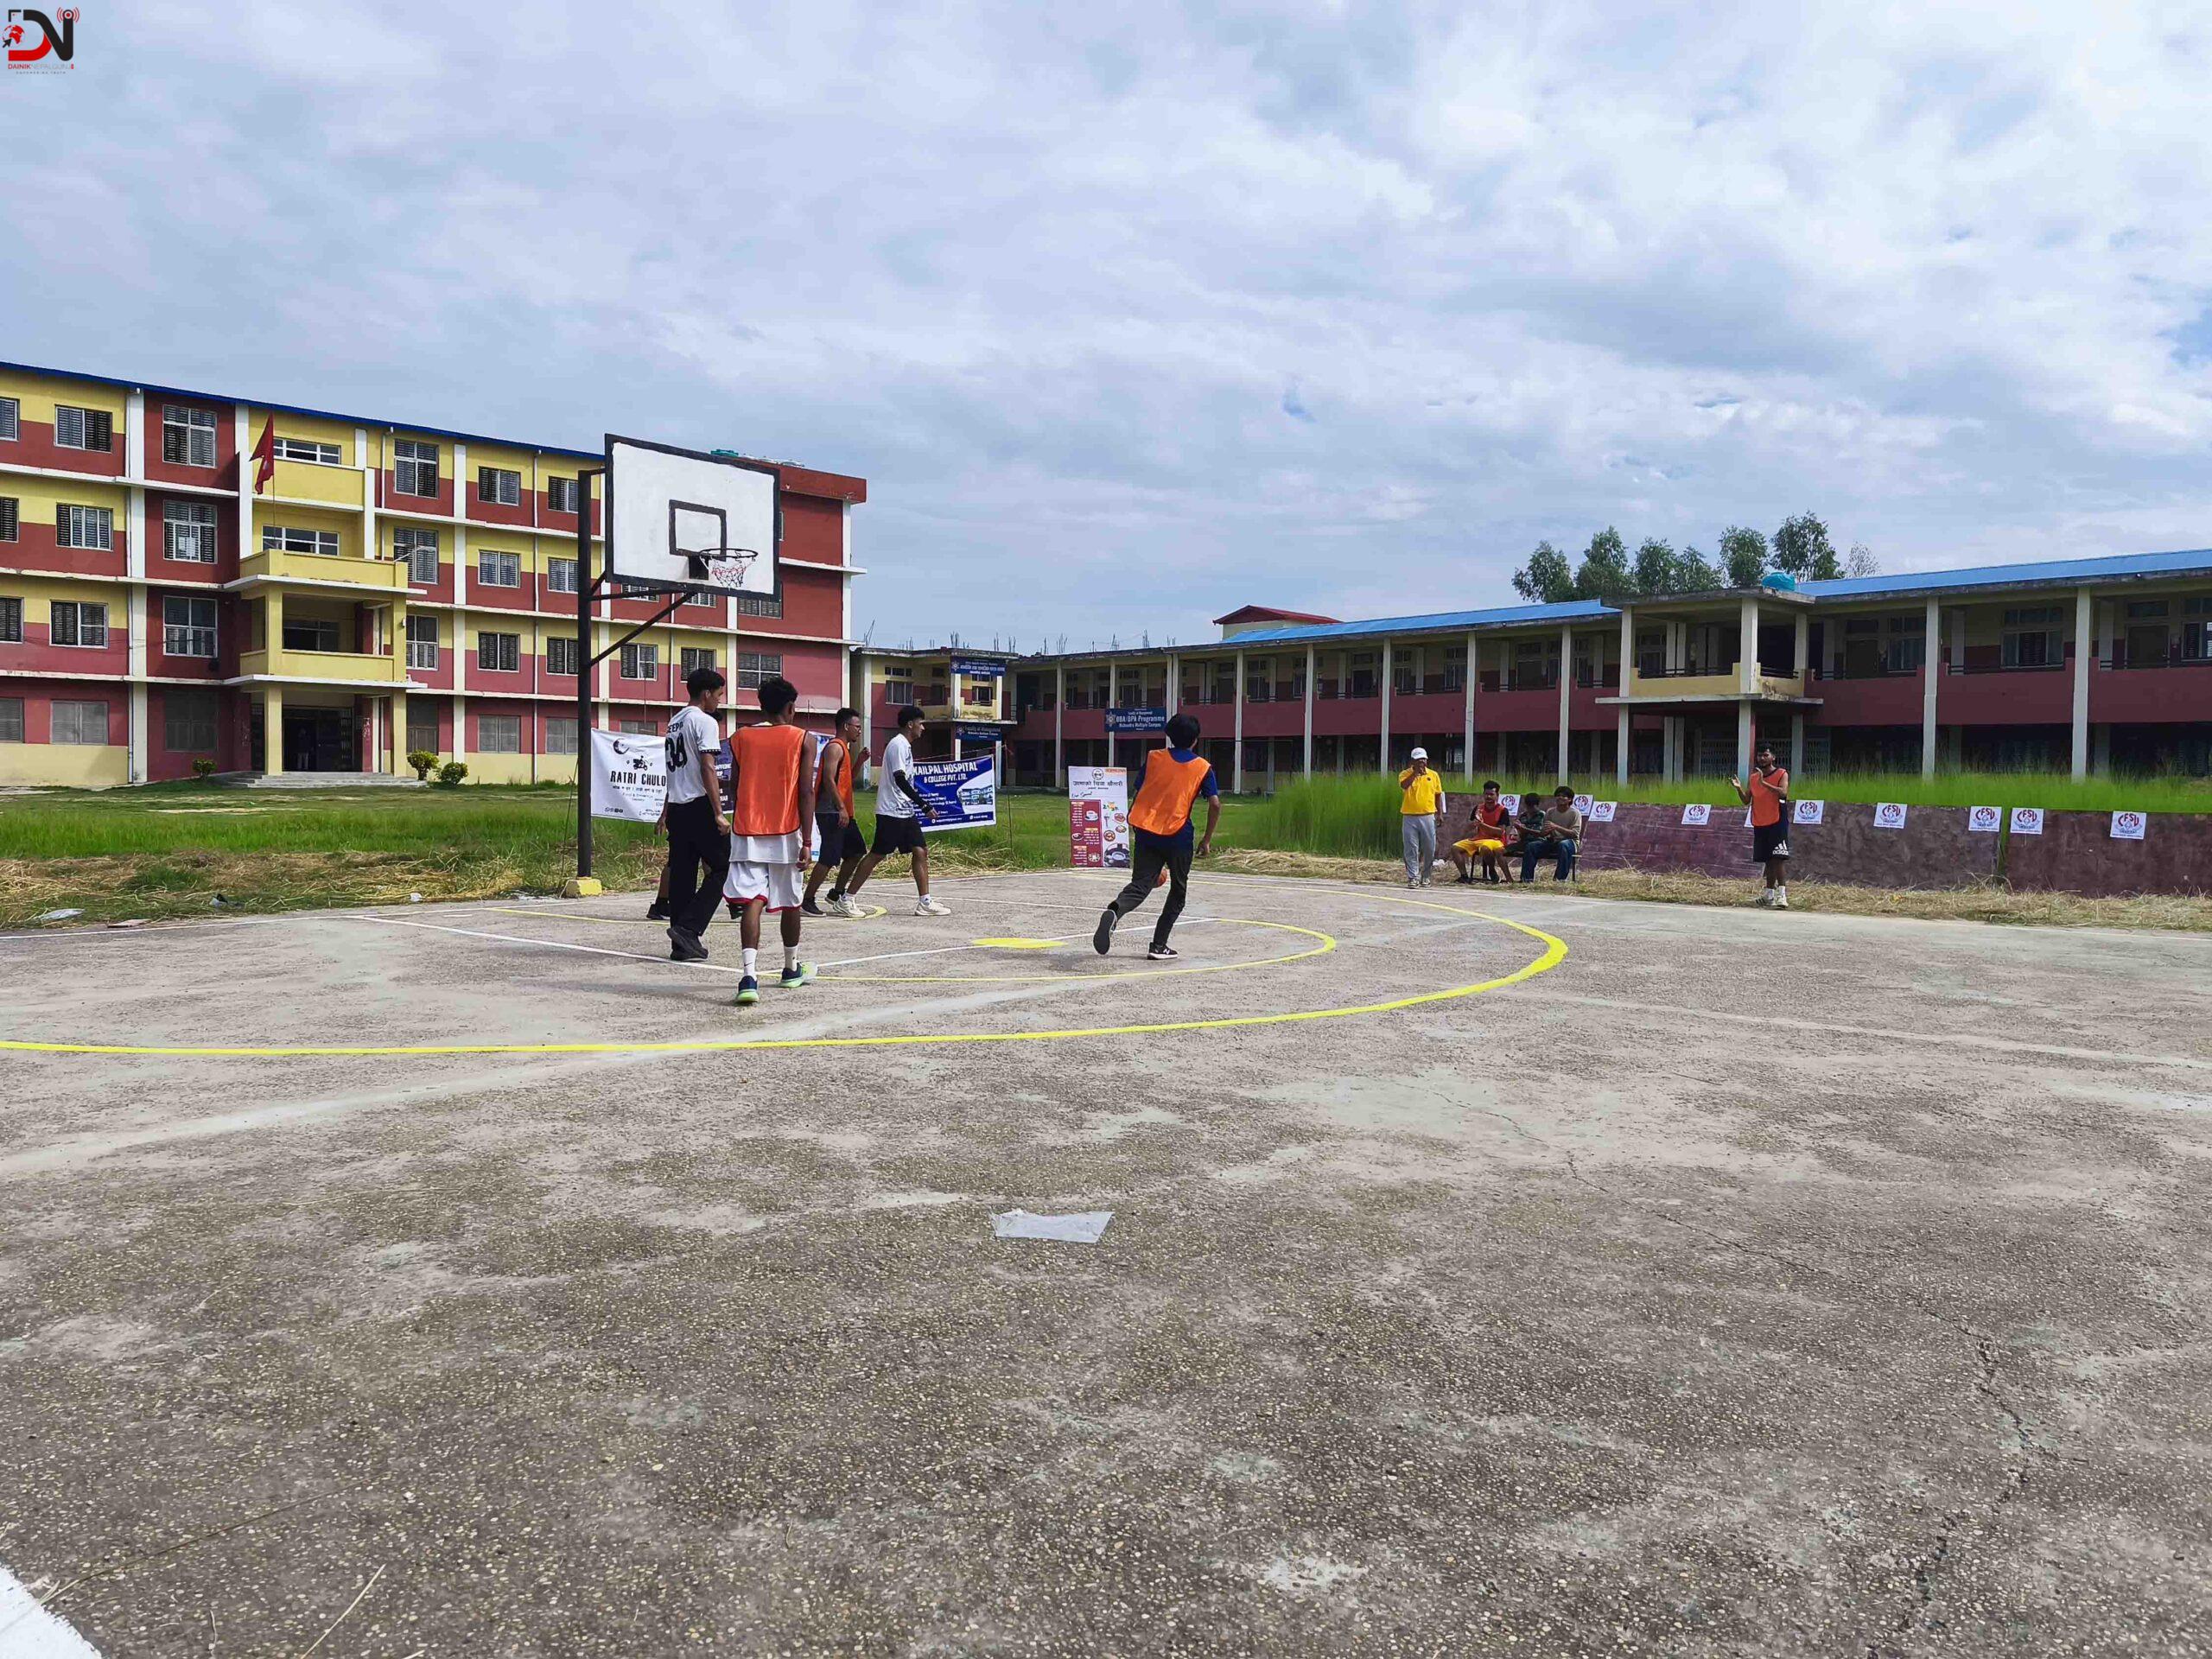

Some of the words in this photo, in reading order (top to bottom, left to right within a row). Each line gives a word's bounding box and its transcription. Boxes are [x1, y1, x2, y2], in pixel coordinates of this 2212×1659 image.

[664, 732, 688, 773] 38
[943, 761, 978, 774] HOSPITAL
[610, 771, 637, 785] RATRI
[641, 773, 666, 787] CHULO
